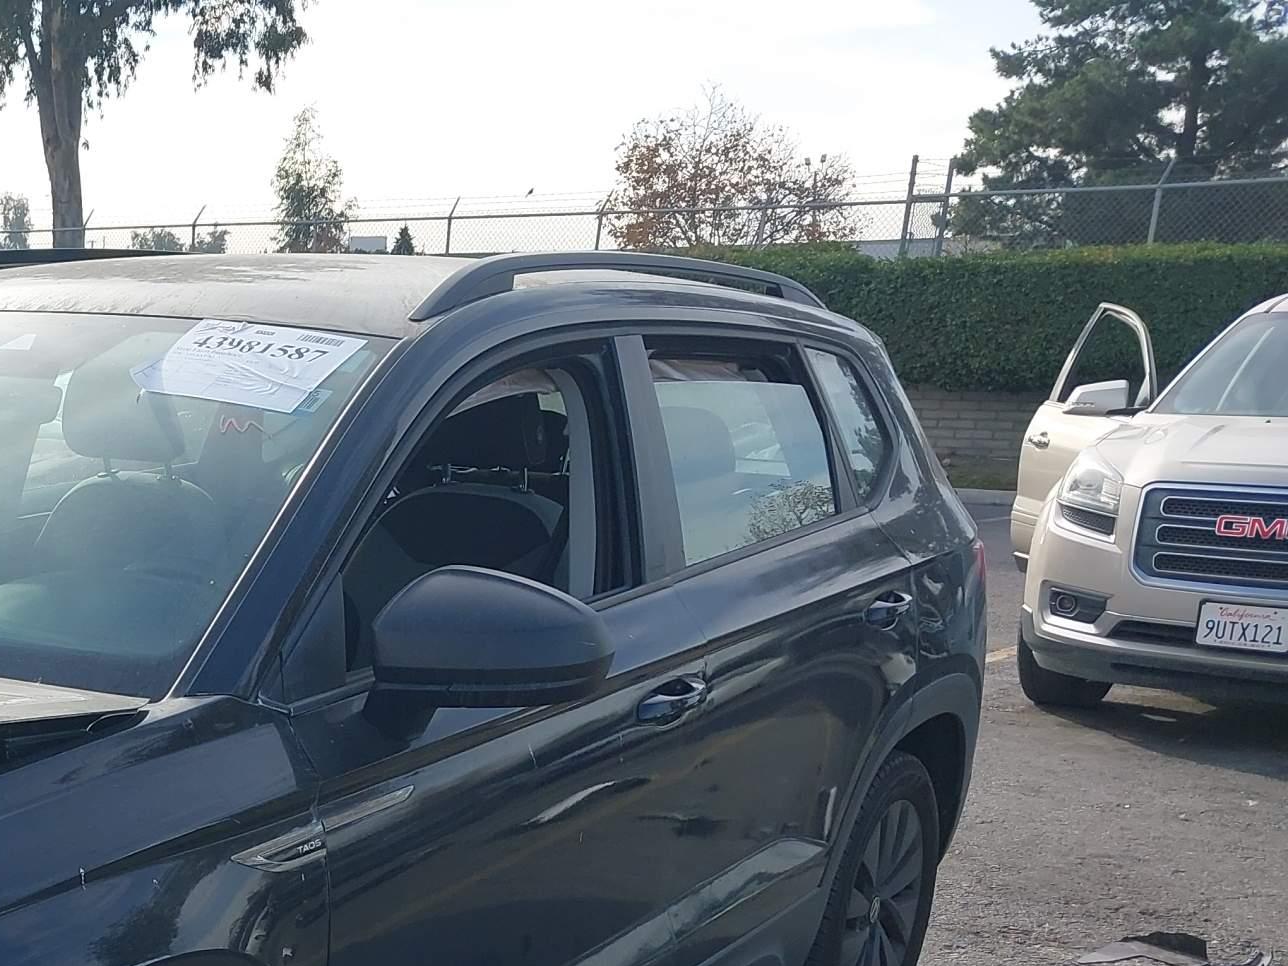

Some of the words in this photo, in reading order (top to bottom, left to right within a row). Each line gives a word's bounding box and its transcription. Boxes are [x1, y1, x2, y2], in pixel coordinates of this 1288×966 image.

[193, 334, 329, 363] 43981587
[1215, 515, 1288, 539] GM
[1220, 607, 1274, 621] California
[1203, 619, 1283, 645] 9UTX121
[296, 838, 322, 854] TAOS
